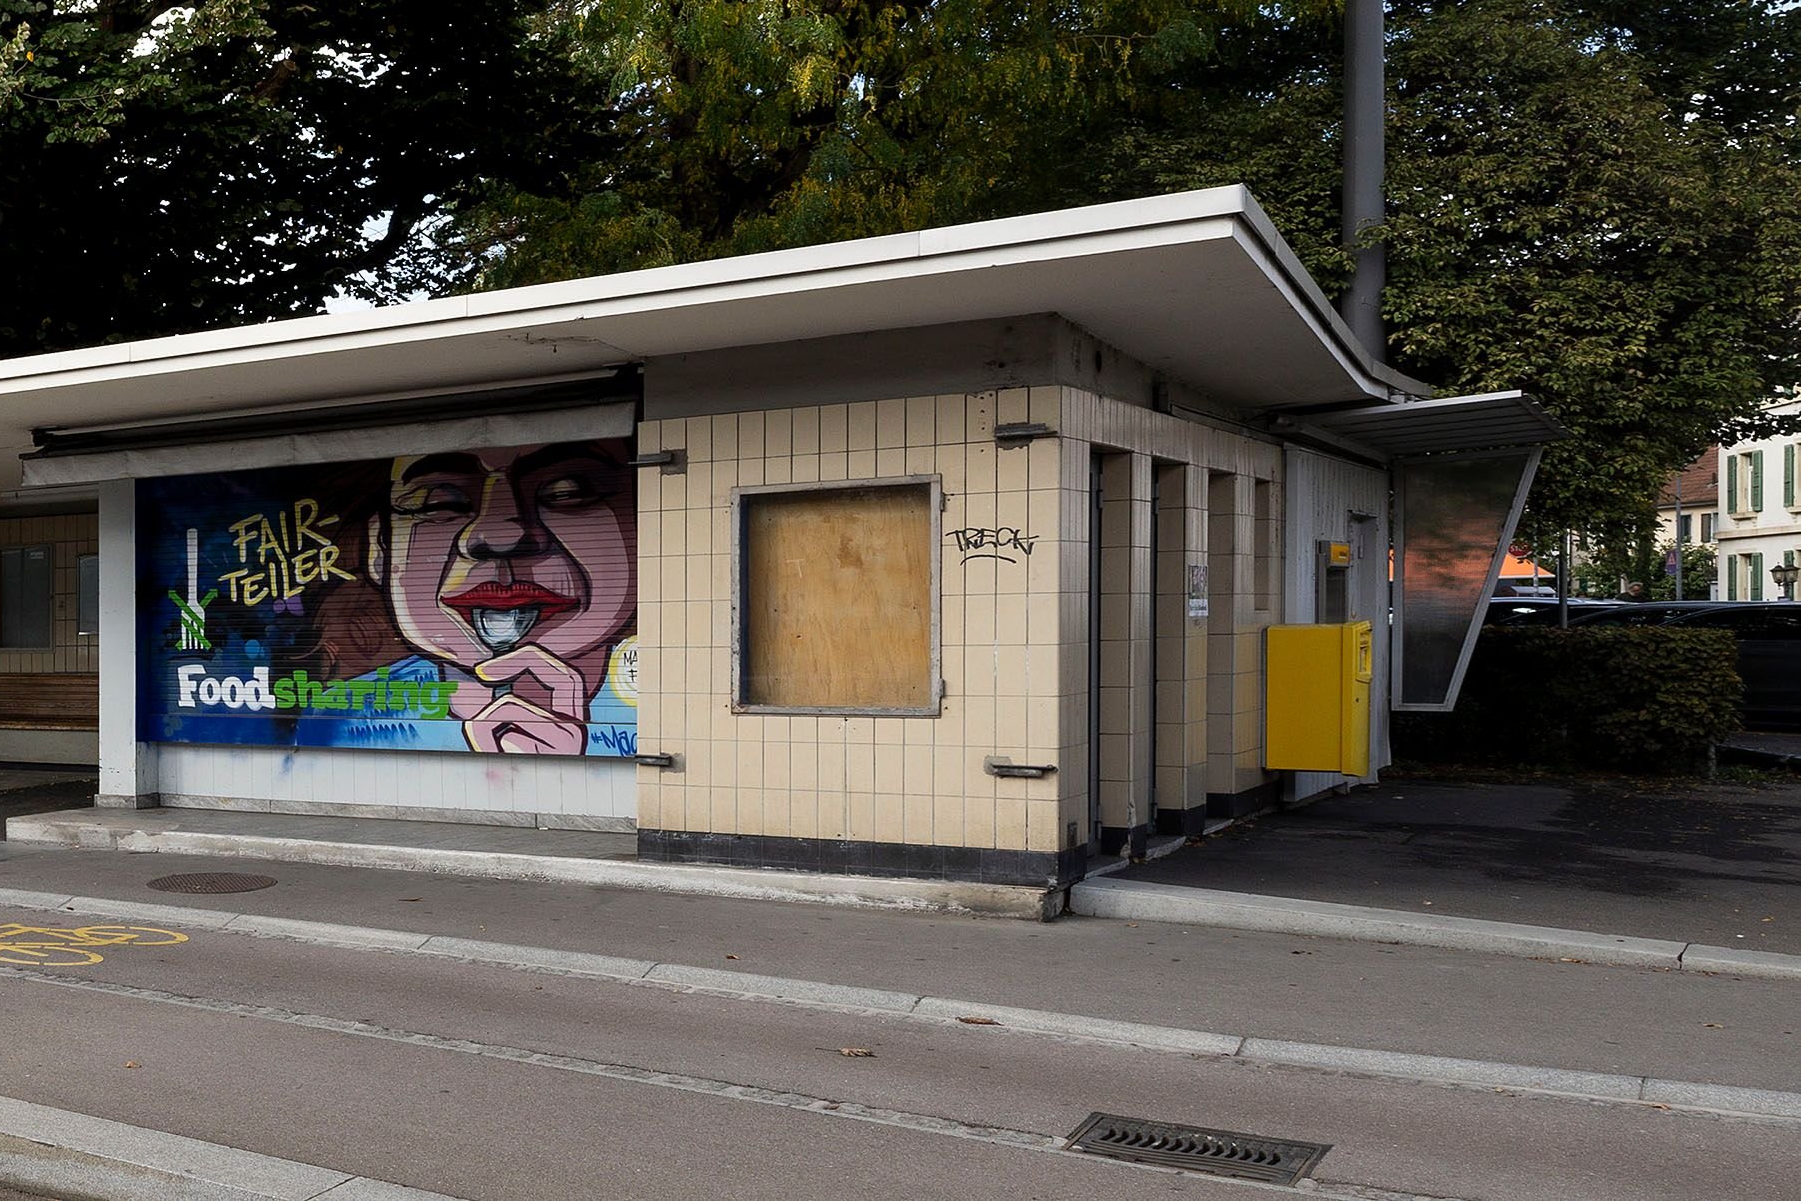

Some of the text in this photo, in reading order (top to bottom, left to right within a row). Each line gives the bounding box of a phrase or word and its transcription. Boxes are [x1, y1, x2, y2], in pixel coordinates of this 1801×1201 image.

[229, 498, 340, 563] FAIR-
[218, 546, 357, 606] TEILER
[178, 664, 459, 719] Foodsharing
